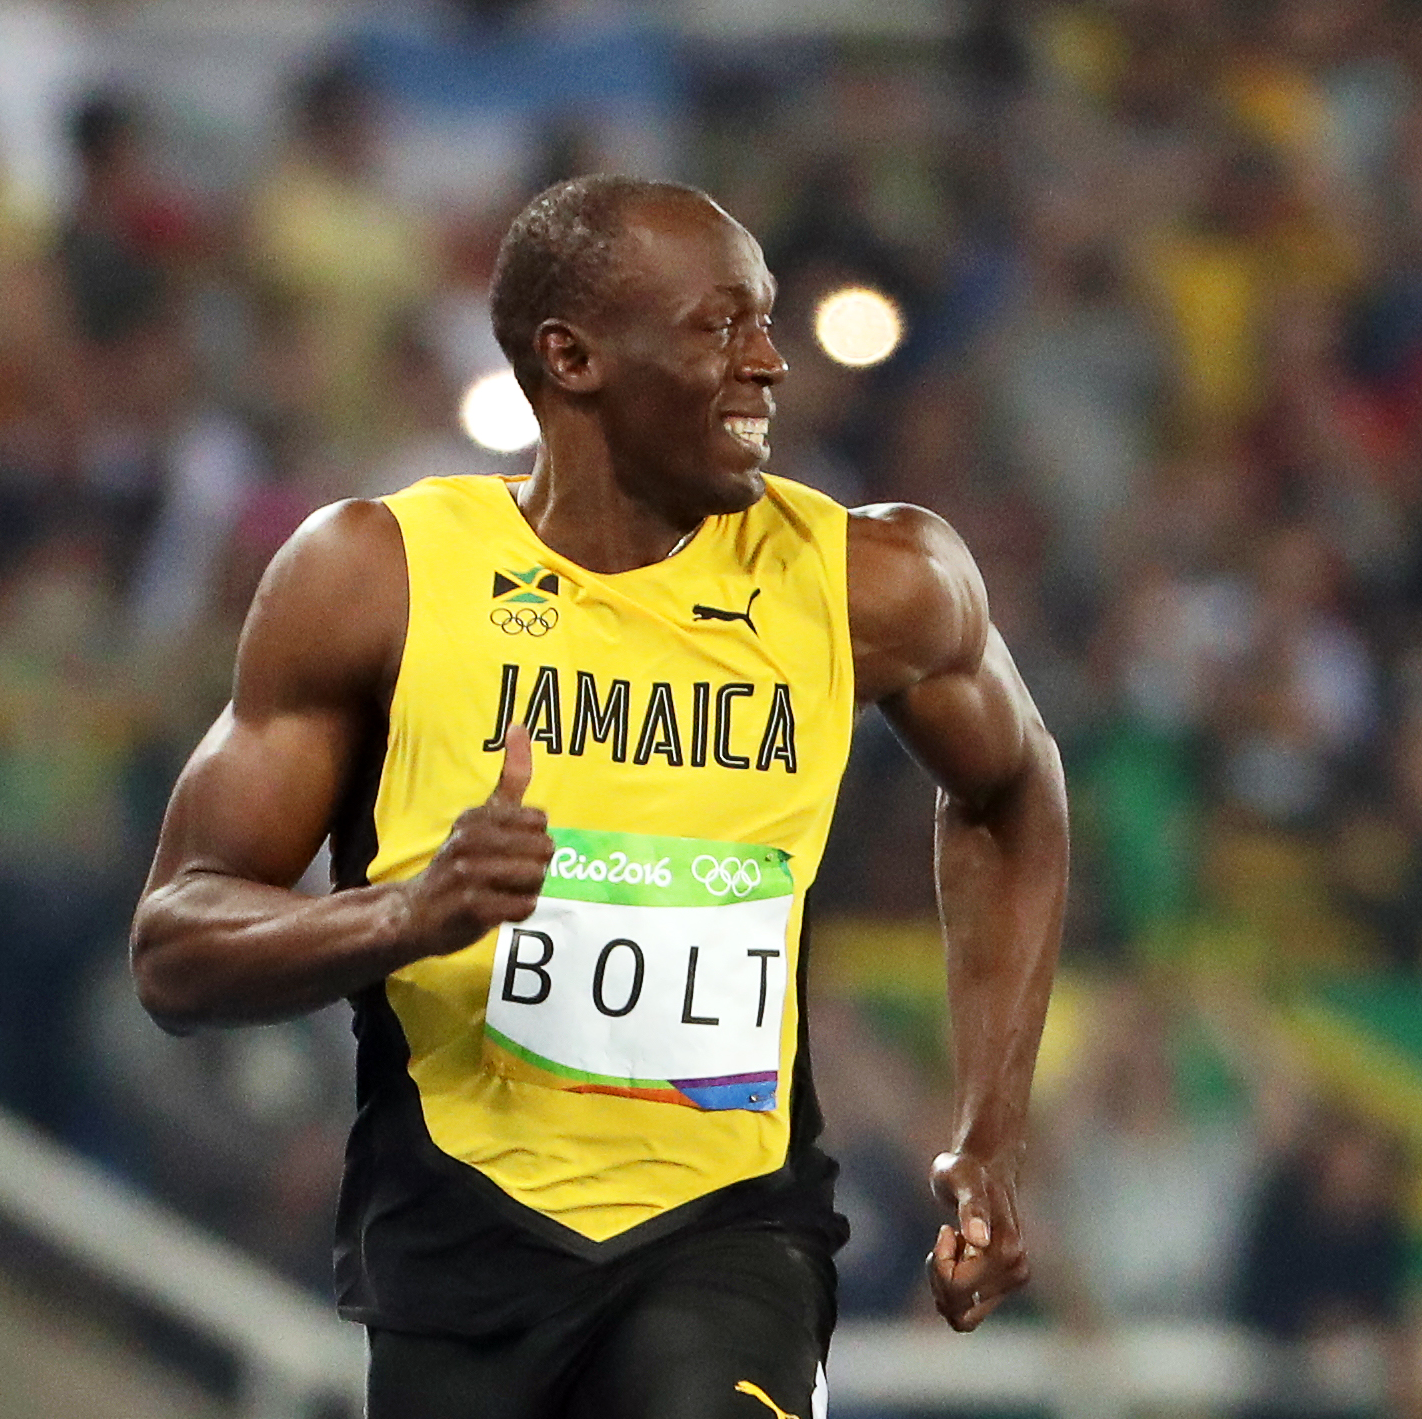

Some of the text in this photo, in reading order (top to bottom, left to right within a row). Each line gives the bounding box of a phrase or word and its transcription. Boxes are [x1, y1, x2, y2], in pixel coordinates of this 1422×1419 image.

[482, 663, 797, 774] JAMAICA
[549, 846, 673, 888] Rio2016
[501, 927, 781, 1028] BOLT
